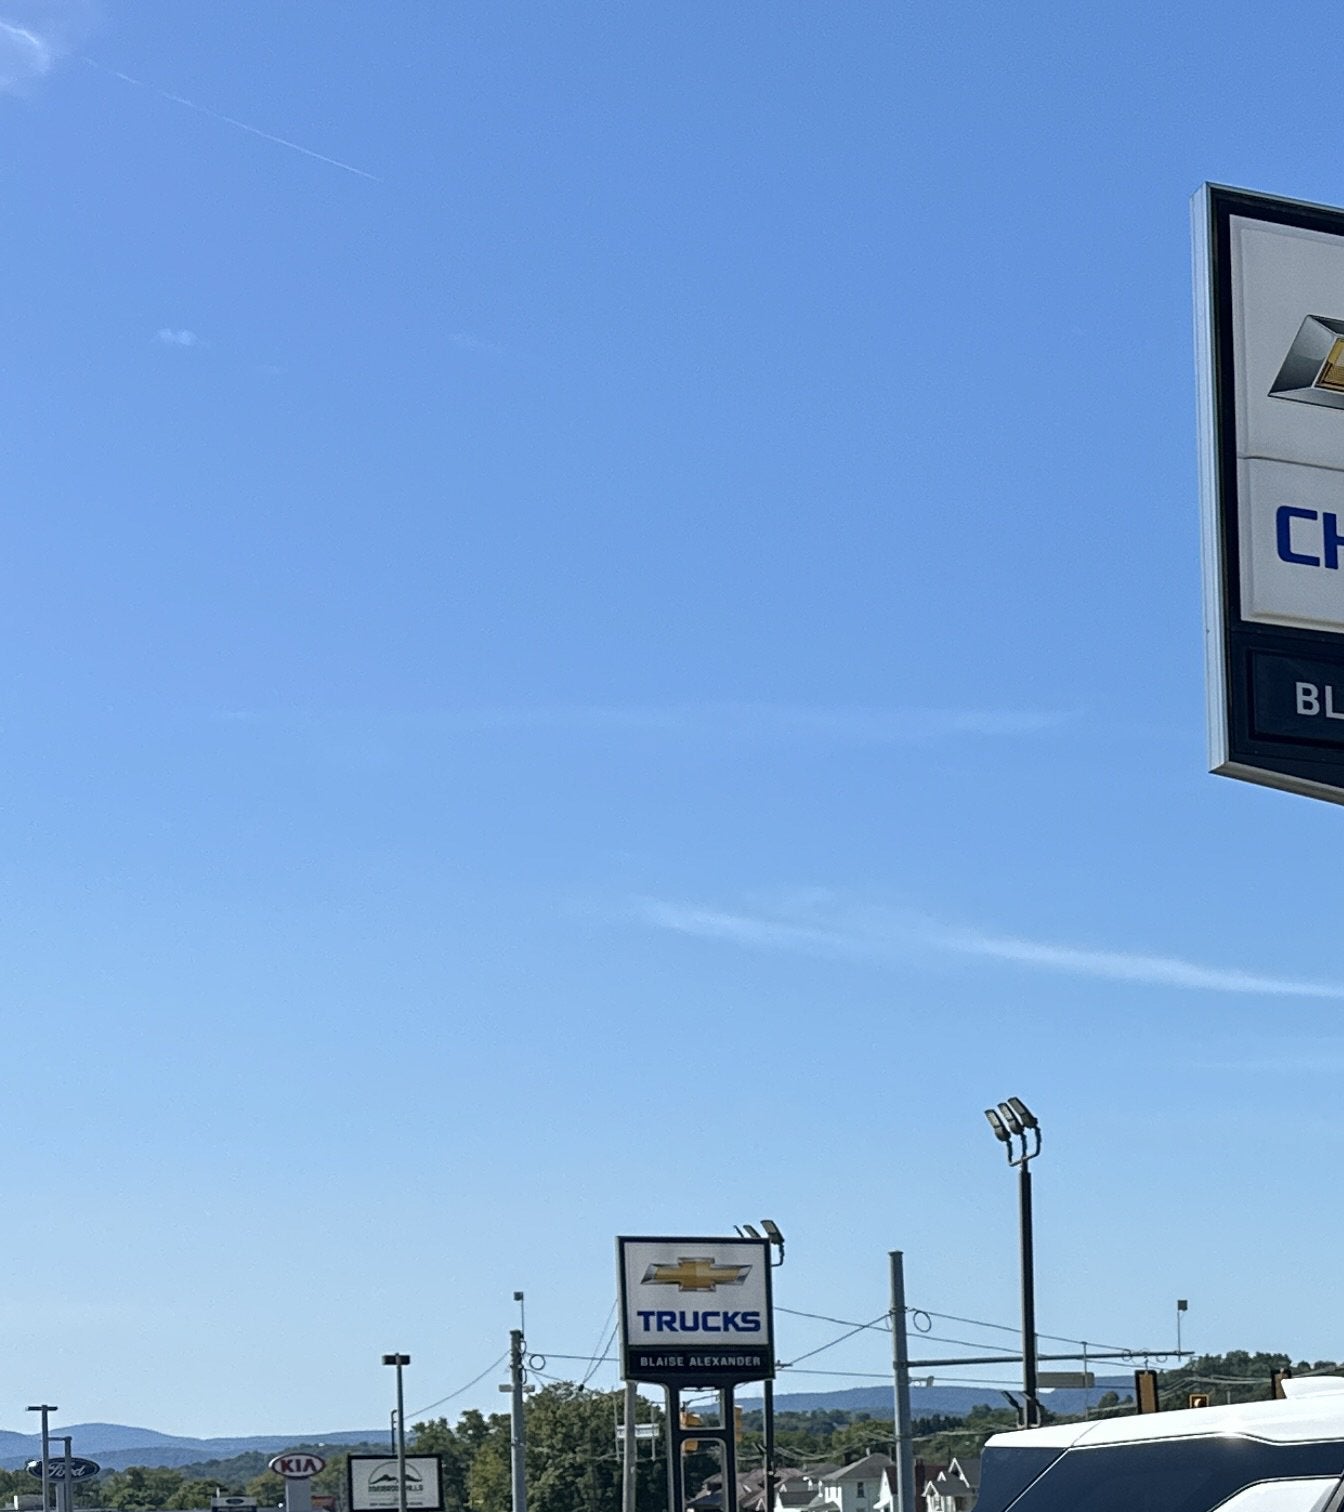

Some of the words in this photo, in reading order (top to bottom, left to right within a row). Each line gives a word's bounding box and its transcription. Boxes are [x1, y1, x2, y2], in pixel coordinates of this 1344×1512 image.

[637, 1310, 761, 1332] TRUCKS
[640, 1356, 685, 1367] BLAISE
[689, 1356, 761, 1367] ALEXANDER
[280, 1458, 317, 1473] KIA
